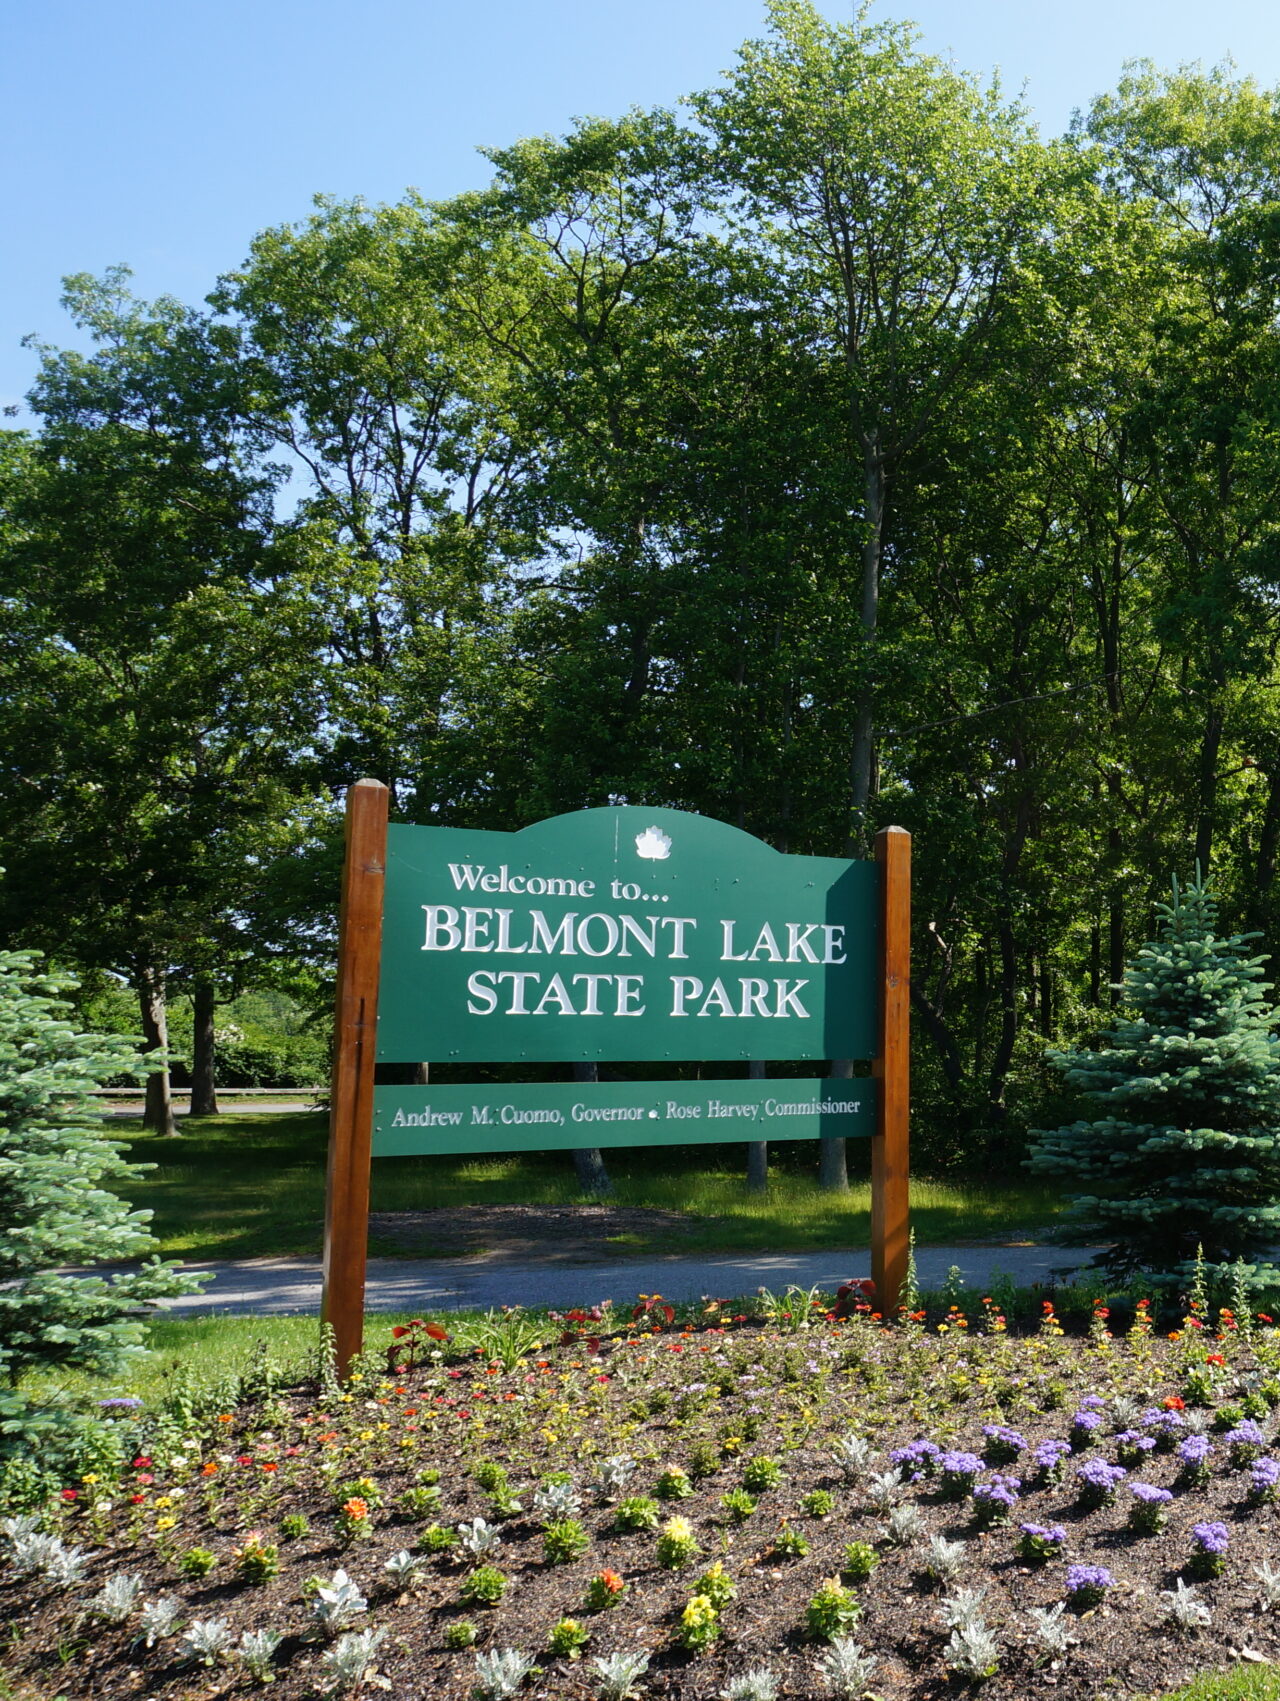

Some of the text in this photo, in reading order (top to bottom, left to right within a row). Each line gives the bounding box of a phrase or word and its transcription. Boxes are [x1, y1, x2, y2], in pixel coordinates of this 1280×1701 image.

[448, 863, 669, 903] Welcome to...
[421, 904, 847, 964] BELMONT LAKE
[467, 970, 811, 1018] STATE PARK
[391, 1095, 861, 1127] Andrew M. Cuomo, Governor Rose Harvey Commissioner
